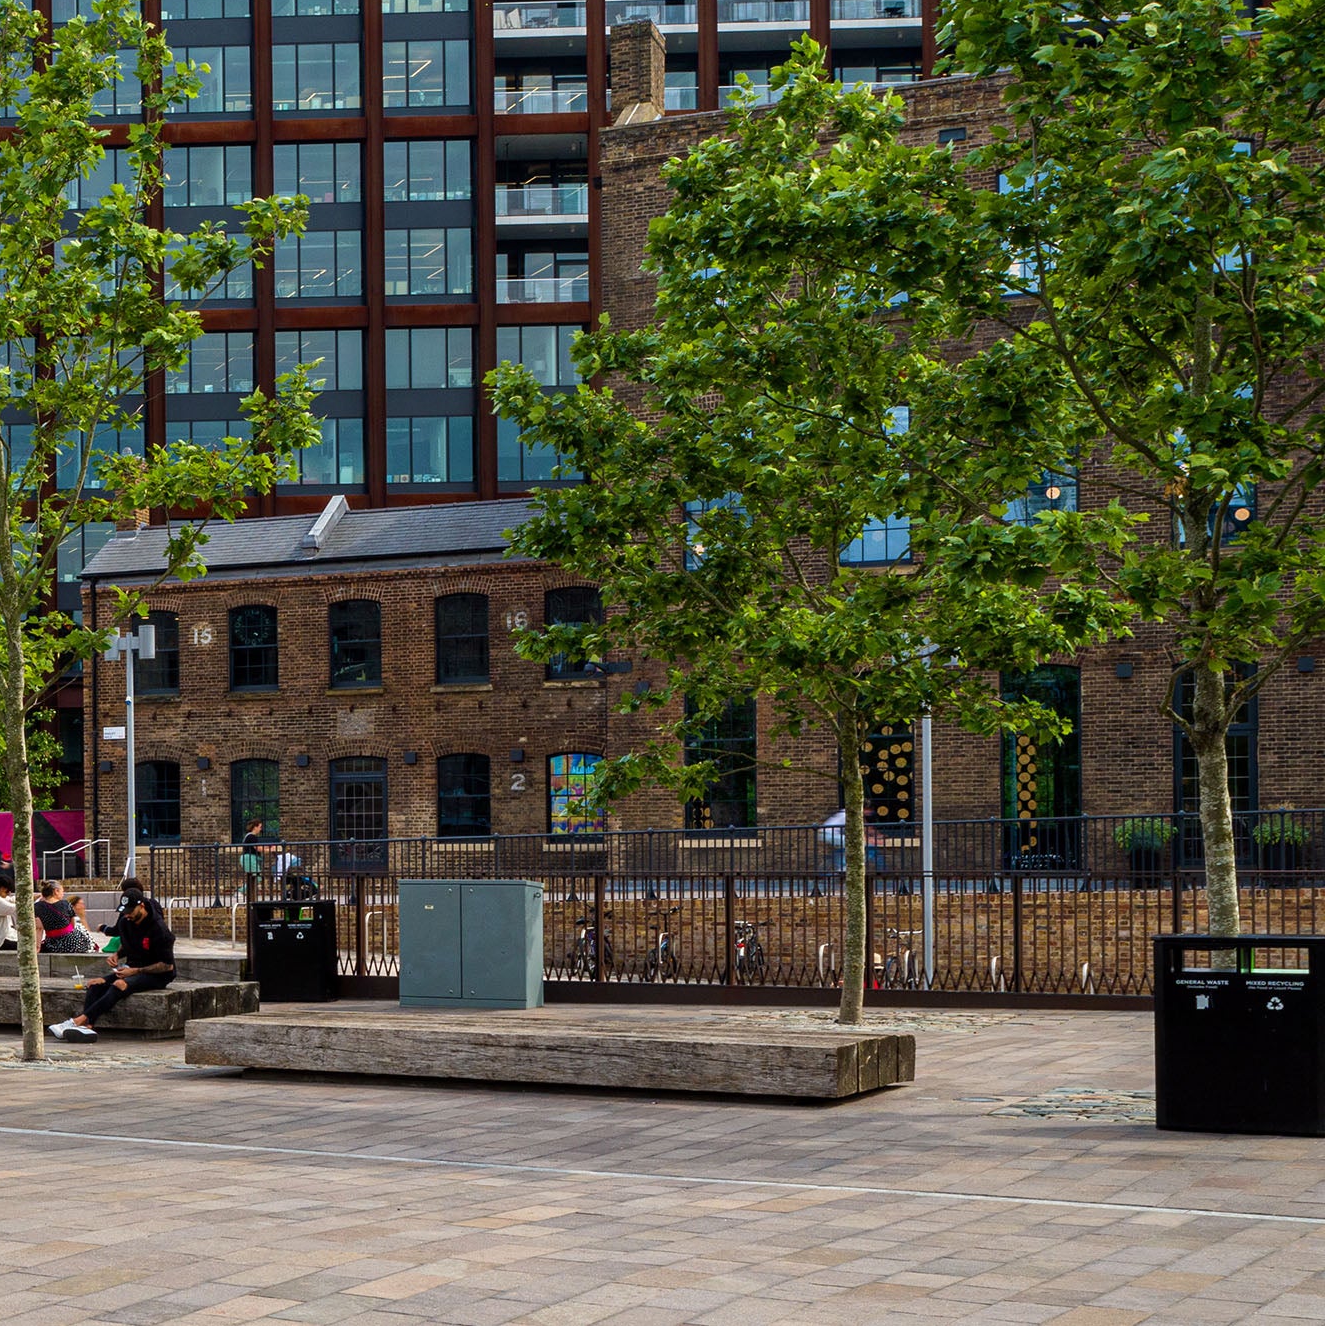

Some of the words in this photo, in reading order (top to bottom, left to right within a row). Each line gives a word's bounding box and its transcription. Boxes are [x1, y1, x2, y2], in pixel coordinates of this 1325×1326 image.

[506, 611, 528, 631] 16
[193, 628, 213, 645] 15
[511, 773, 526, 791] 2
